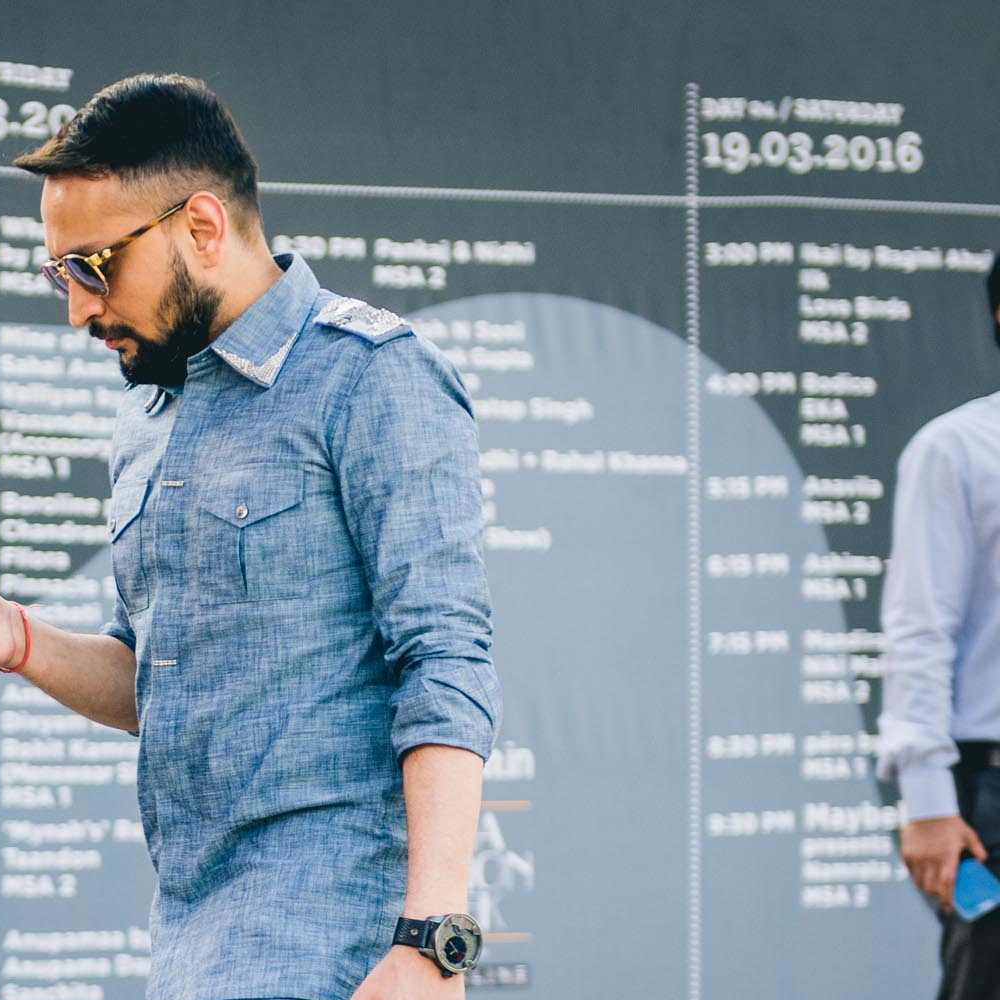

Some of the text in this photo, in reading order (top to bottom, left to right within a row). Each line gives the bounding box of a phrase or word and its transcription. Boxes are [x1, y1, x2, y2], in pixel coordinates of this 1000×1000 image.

[701, 97, 747, 121] DAY
[794, 98, 905, 126] SATURDAY
[701, 131, 924, 173] 19.03.2016
[328, 236, 366, 258] PM
[759, 242, 794, 264] PM
